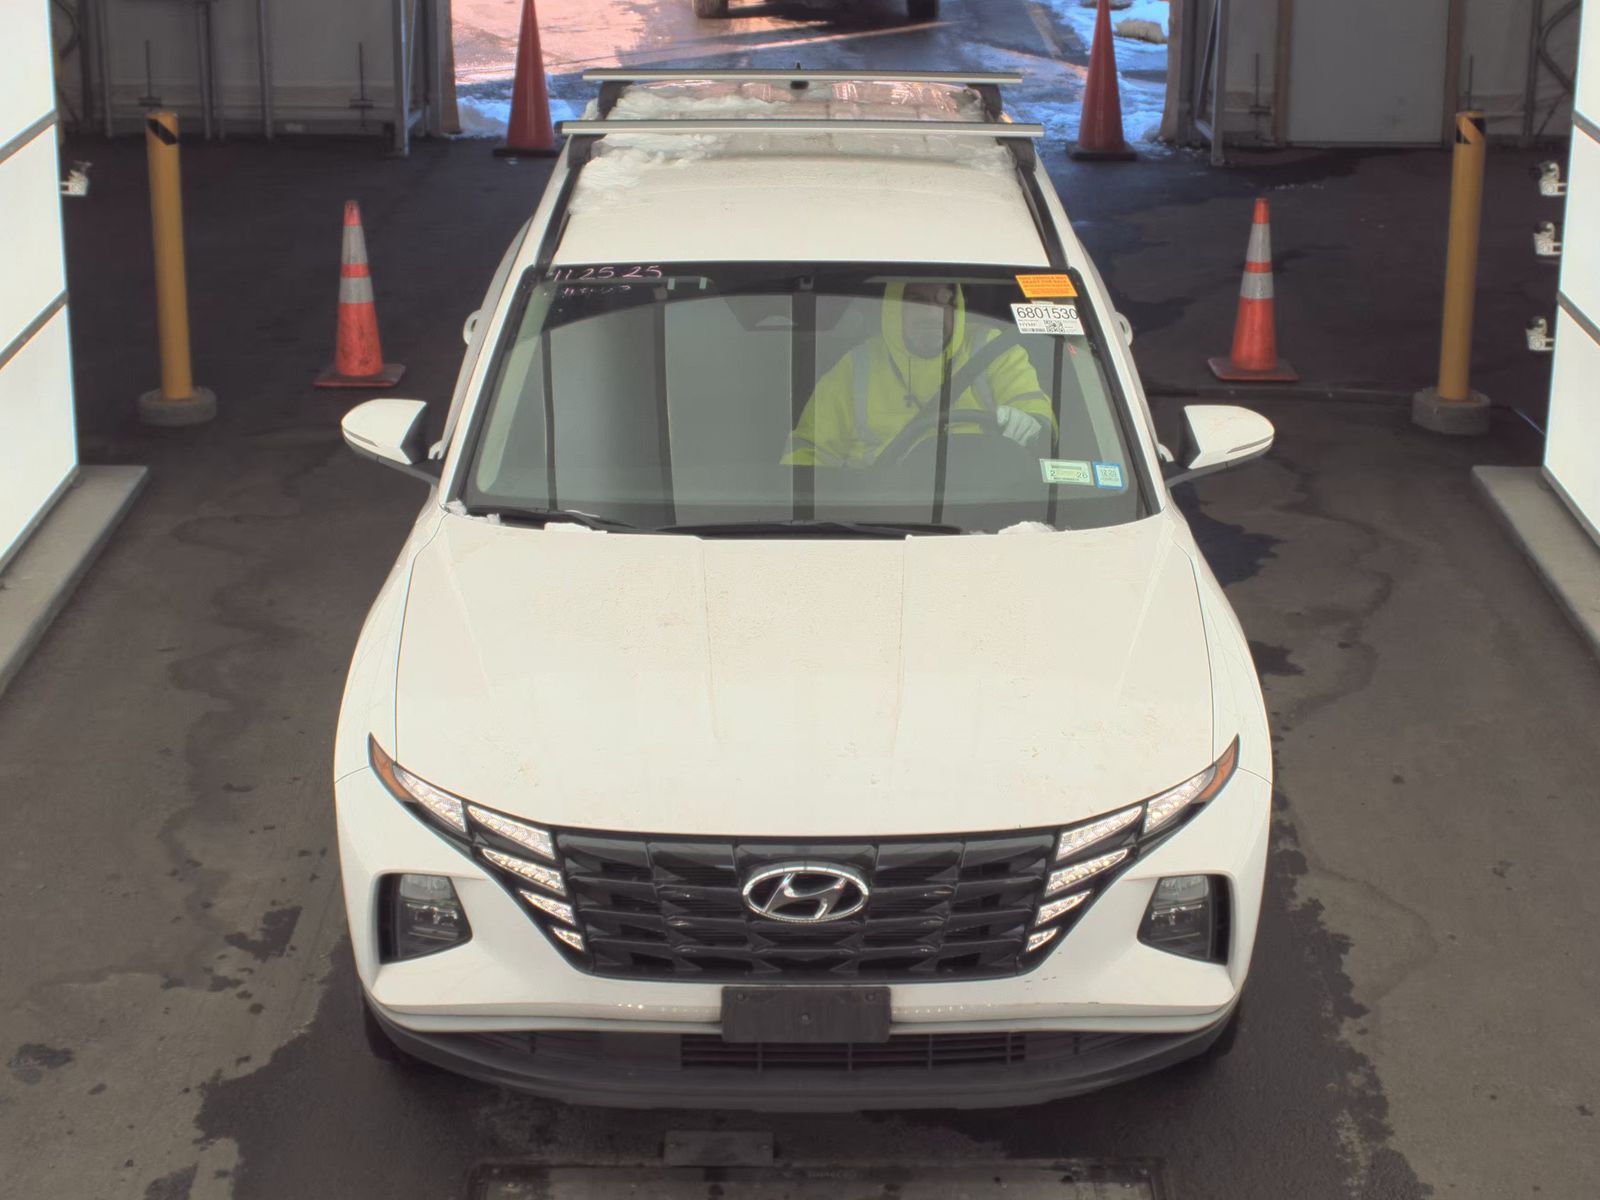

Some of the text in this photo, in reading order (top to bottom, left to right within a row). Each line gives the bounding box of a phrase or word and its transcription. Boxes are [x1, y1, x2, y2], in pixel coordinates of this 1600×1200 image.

[579, 266, 615, 280] 25
[622, 265, 663, 279] 25
[1016, 307, 1079, 320] 6801530
